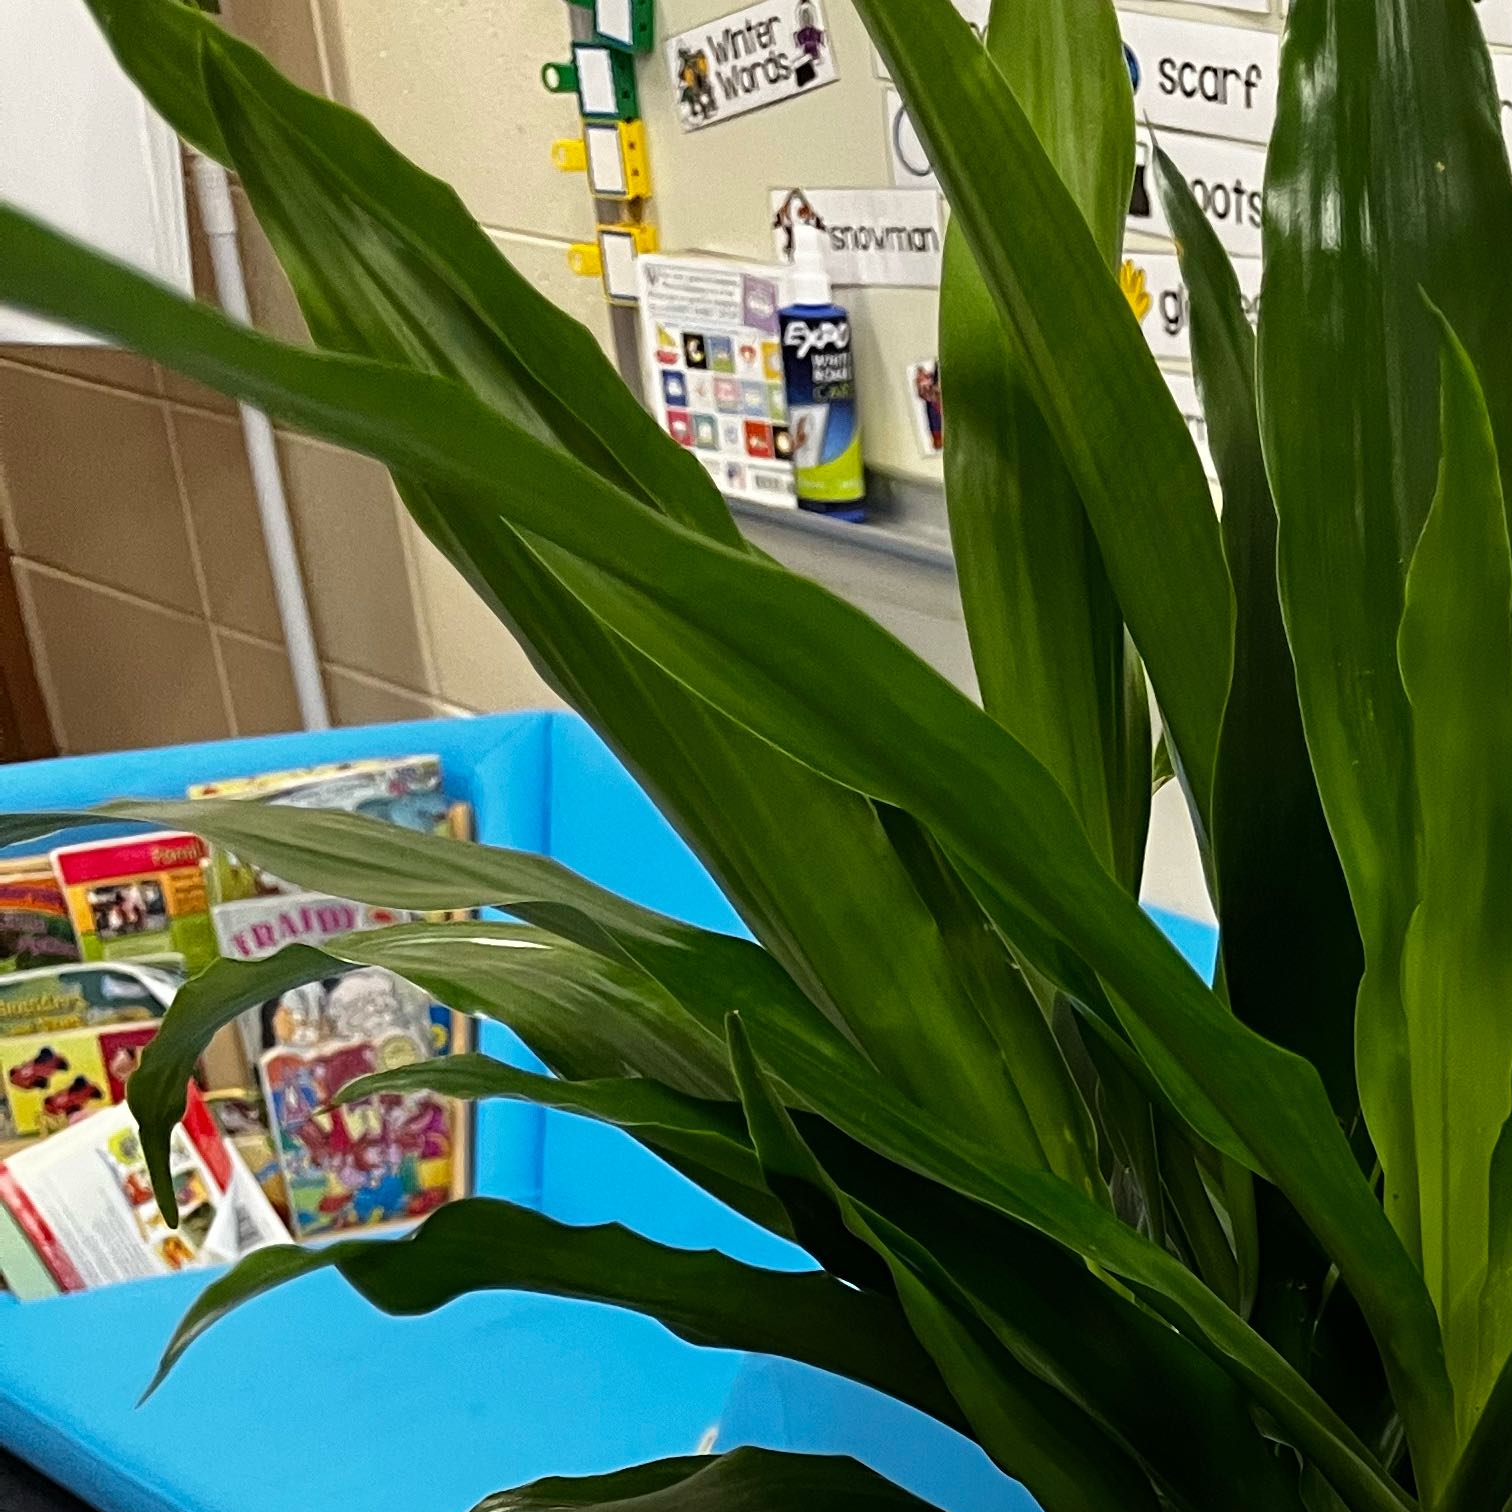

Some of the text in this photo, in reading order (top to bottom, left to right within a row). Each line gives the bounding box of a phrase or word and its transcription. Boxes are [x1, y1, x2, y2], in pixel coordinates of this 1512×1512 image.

[706, 15, 781, 64] Winter
[716, 49, 794, 100] Words
[1158, 57, 1262, 109] scarf
[1191, 178, 1262, 229] oots
[829, 226, 940, 253] snowman
[784, 321, 850, 360] EXPO
